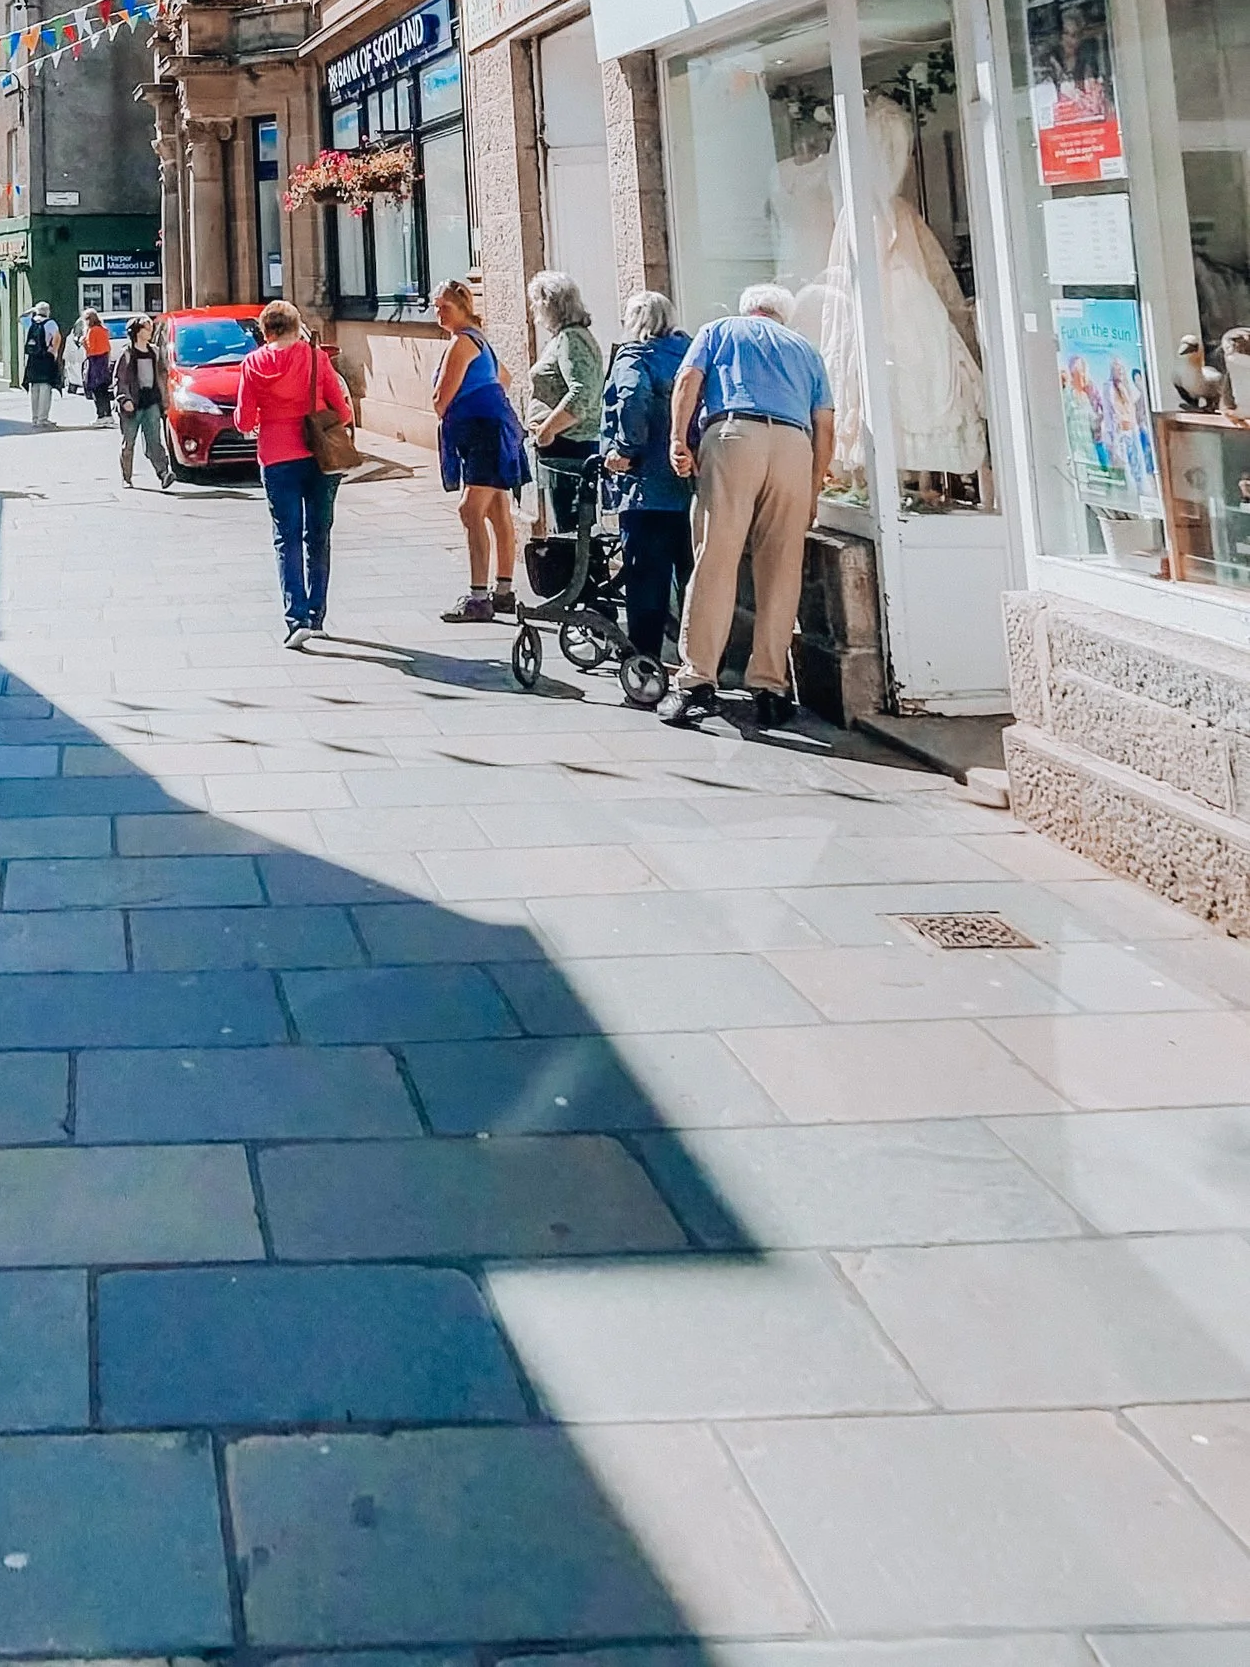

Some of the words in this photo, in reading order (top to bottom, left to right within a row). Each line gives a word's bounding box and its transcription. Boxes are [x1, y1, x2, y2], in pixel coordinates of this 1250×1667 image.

[337, 48, 361, 88] BANK
[359, 43, 373, 75] OF
[373, 14, 424, 68] SCOTLAND
[80, 256, 103, 268] HM
[140, 261, 156, 270] LLP
[1061, 325, 1079, 339] Fun
[1080, 325, 1090, 337] in
[1091, 322, 1109, 338] the
[1111, 326, 1131, 342] sun
